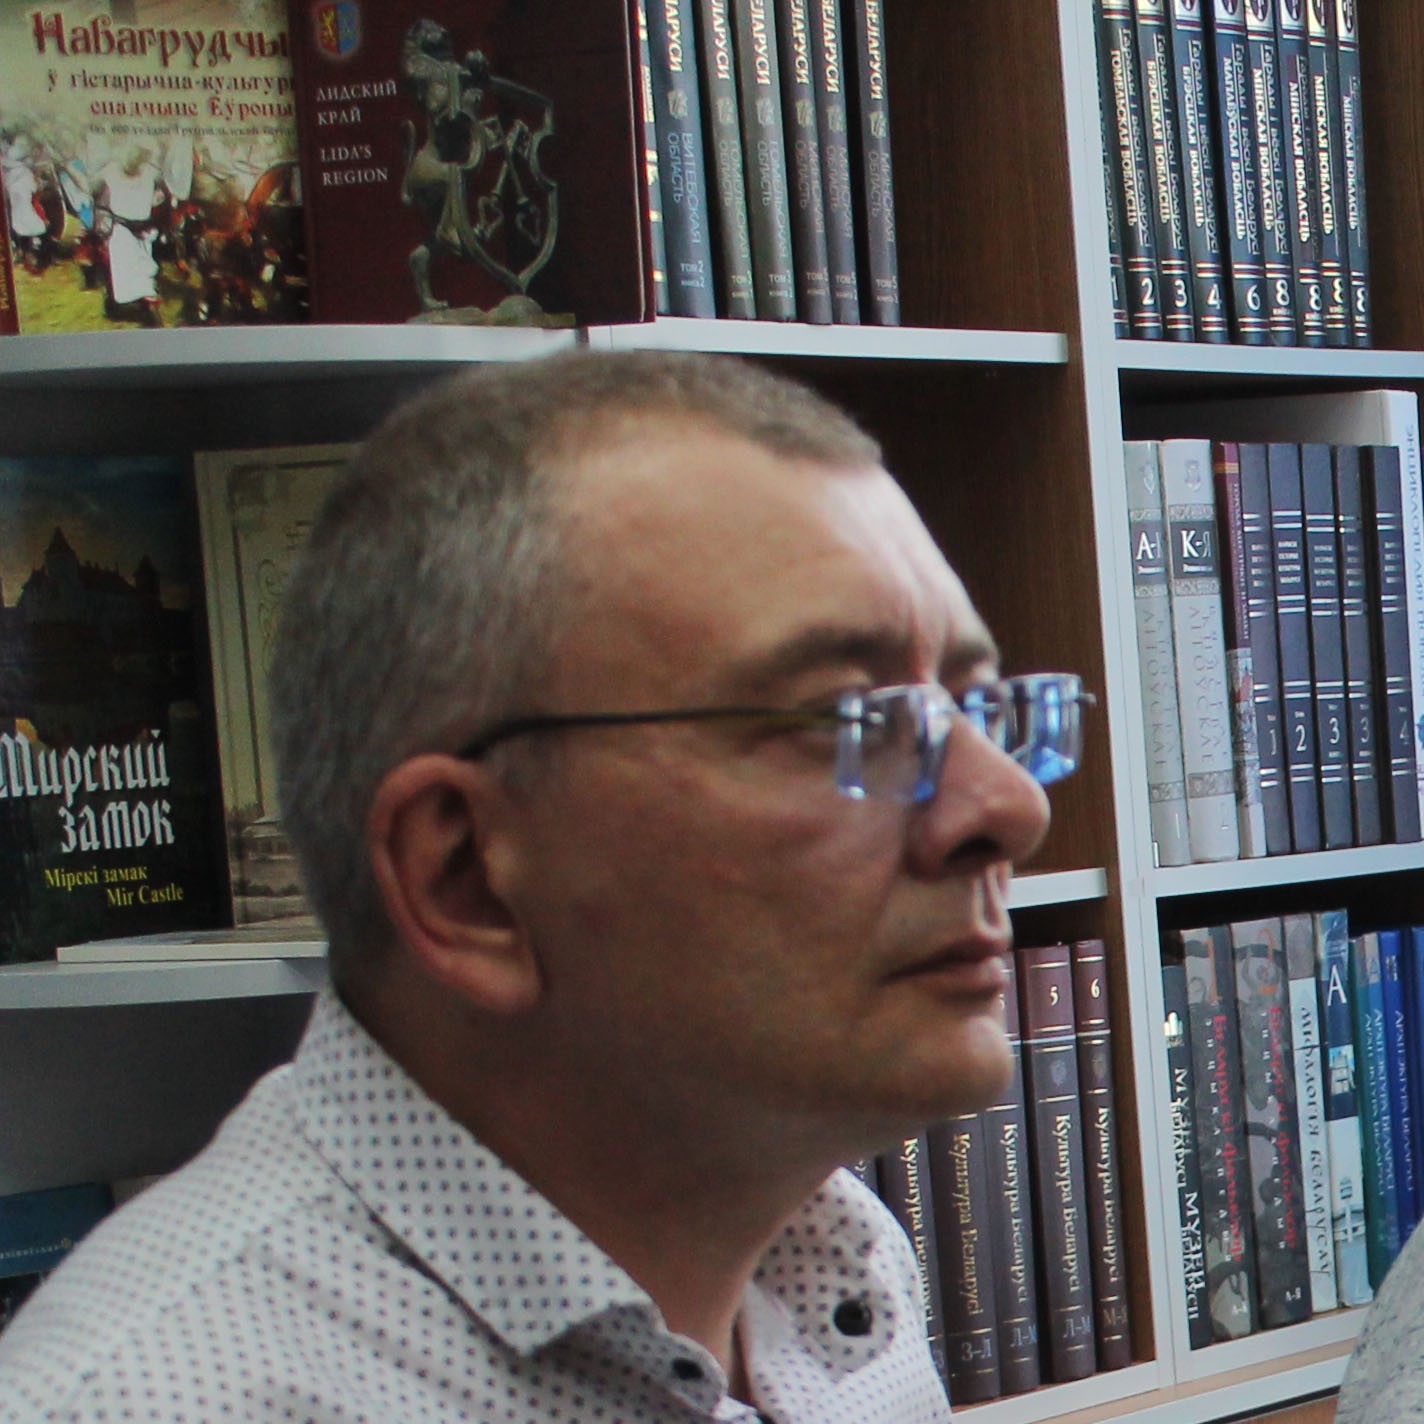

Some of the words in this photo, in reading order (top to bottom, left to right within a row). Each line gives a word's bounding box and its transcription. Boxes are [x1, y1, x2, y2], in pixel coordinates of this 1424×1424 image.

[865, 0, 884, 100] БЕЛАРУСИ
[317, 79, 397, 101] ЛИДСКИЙ
[318, 105, 361, 125] КРАЙ
[1146, 60, 1164, 139] БРЭСЦКАЯ
[1182, 66, 1198, 144] БРЭСЦКАЯ
[1252, 68, 1268, 143] МІНСКАЯ
[1289, 81, 1305, 155] МІНСКАЯ
[1314, 75, 1329, 148] МІНСКАЯ
[321, 144, 372, 162] LIDA'S
[667, 132, 683, 203] ОБЛАСТЬ
[757, 141, 772, 206] ОБЛАСТЬ
[1111, 49, 1129, 145] ГОМЕЛЬСКАЯ
[1121, 150, 1138, 226] ВОБЛАСЦЬ
[323, 167, 388, 186] REGION
[682, 132, 701, 244] ВИТЕБСКАЯ
[868, 151, 881, 217] ОБЛАСТЬ
[881, 151, 895, 243] МИНСКАЯ
[1154, 146, 1171, 223] ВОБЛАСЦЬ
[1189, 150, 1205, 227] ВОБЛАСЦЬ
[1231, 162, 1247, 240] ВОБЛАСЦЬ
[1259, 147, 1275, 230] ВОБЛАСЦЬ
[1294, 159, 1310, 242] ВОБЛАСЦЬ
[1319, 152, 1334, 235] ВОБЛАСЦЬ
[1141, 277, 1155, 305] 2
[1174, 279, 1187, 307] 3
[1208, 284, 1221, 309] 4
[1247, 284, 1260, 311] 6
[1276, 279, 1290, 306] 8
[1310, 285, 1322, 311] 8
[1181, 530, 1211, 558] К-Я
[1270, 728, 1277, 755] 1
[1295, 725, 1307, 752] 2
[1329, 717, 1340, 744] 3
[1360, 717, 1370, 743] 3
[0, 729, 171, 808] Мирский
[58, 799, 175, 853] замок
[44, 865, 99, 892] Мірскі
[103, 866, 148, 883] замак
[106, 887, 135, 907] Mir
[138, 882, 184, 904] Castle
[1050, 986, 1058, 1006] 5
[1091, 979, 1100, 998] 6
[1327, 965, 1347, 1006] А
[902, 1138, 925, 1231] Культура
[953, 1133, 974, 1224] Культура
[1003, 1123, 1022, 1213] Культура
[1055, 1115, 1074, 1203] Культура
[1097, 1107, 1114, 1195] Культура
[959, 1230, 983, 1315] Беларусі
[1012, 1218, 1029, 1302] Беларусі
[1062, 1208, 1081, 1292] Беларусі
